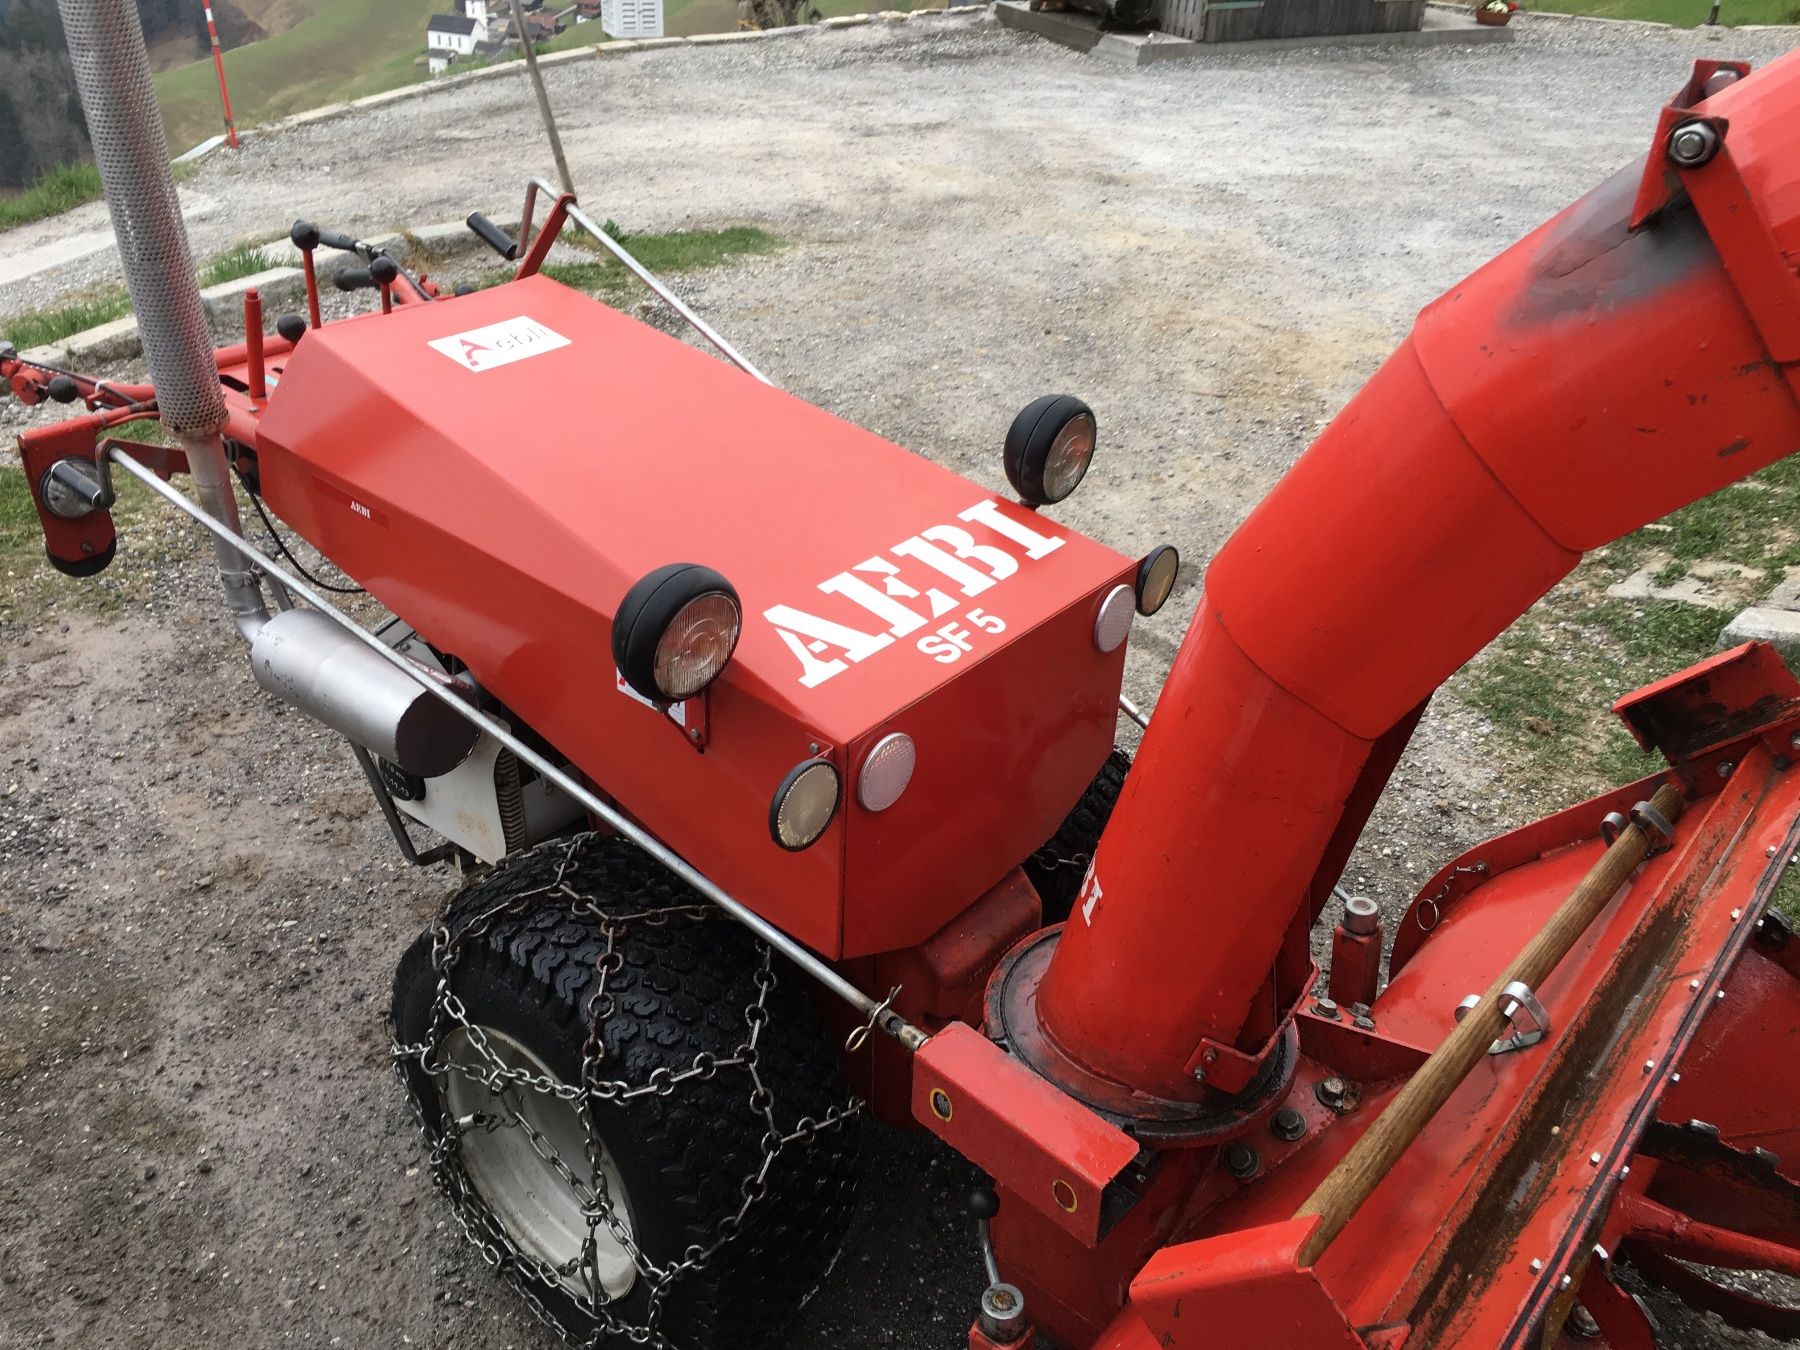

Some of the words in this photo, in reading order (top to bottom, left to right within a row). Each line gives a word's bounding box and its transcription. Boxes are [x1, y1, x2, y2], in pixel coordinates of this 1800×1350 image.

[762, 498, 1067, 689] AEBI
[916, 621, 974, 664] SF
[965, 607, 1007, 634] 5
